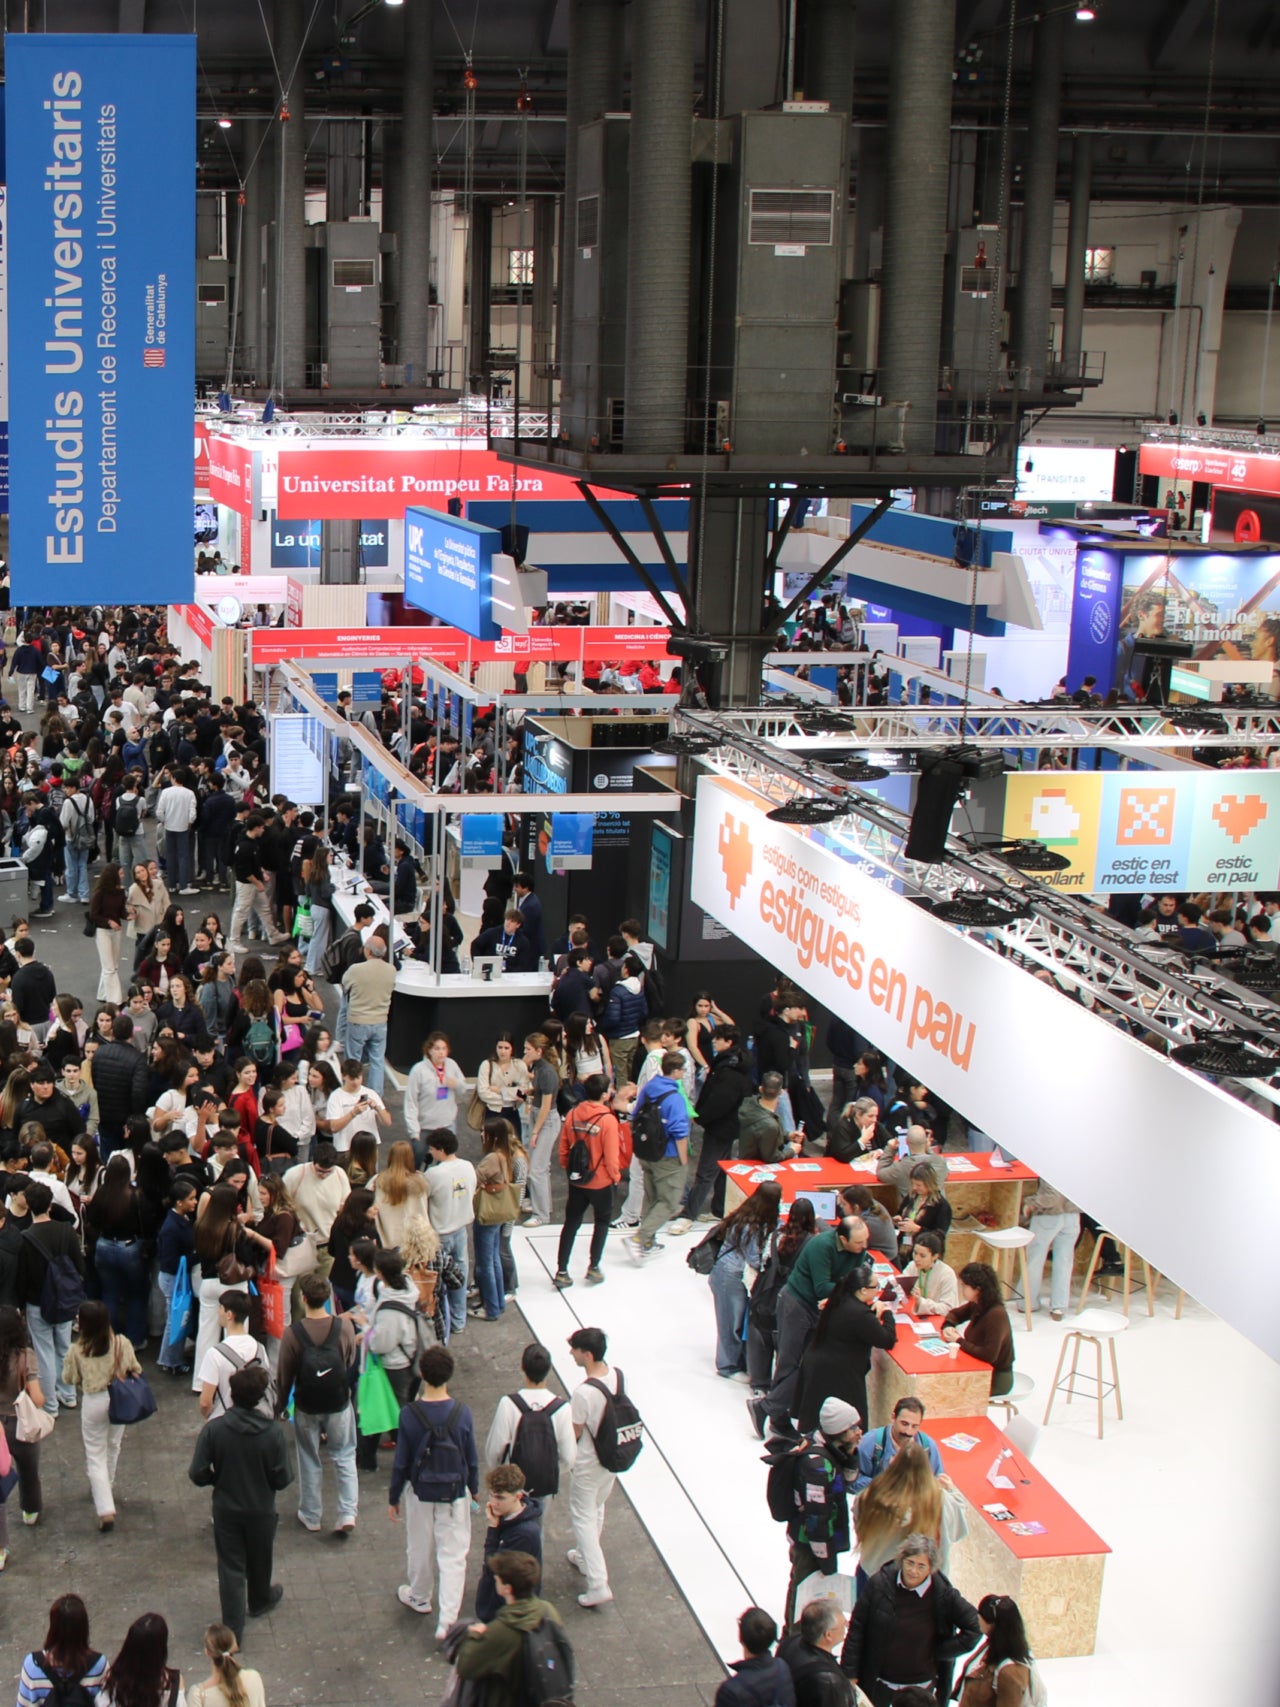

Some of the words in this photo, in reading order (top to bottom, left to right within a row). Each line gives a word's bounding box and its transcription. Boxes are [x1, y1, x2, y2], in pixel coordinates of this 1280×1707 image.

[97, 104, 116, 235] Universitats
[43, 71, 84, 374] Universitaris
[97, 257, 117, 350] Recerca
[156, 274, 167, 327] Catalunya
[145, 285, 155, 344] Generalitat
[156, 331, 166, 344] de
[97, 355, 117, 384] de
[97, 390, 119, 534] Departament
[1231, 465, 1246, 478] 40
[46, 390, 84, 564] Estudis
[283, 475, 396, 494] Universitat
[401, 475, 480, 499] Pompeu
[486, 474, 544, 492] Fabra
[275, 532, 294, 546] La
[1173, 608, 1189, 625] El
[1194, 608, 1221, 625] teu
[1184, 625, 1199, 641] al
[1202, 624, 1243, 641] món
[763, 845, 796, 879] estiguis
[797, 867, 819, 895] com
[1111, 857, 1150, 871] estic
[1151, 860, 1171, 871] en
[1216, 855, 1253, 869] estic
[1101, 870, 1146, 885] mode
[1148, 871, 1179, 884] test
[1207, 872, 1226, 883] en
[1227, 870, 1258, 886] pau
[495, 943, 517, 955] UPC
[760, 880, 866, 990] estigues
[868, 957, 908, 1023] en
[906, 985, 977, 1072] pau
